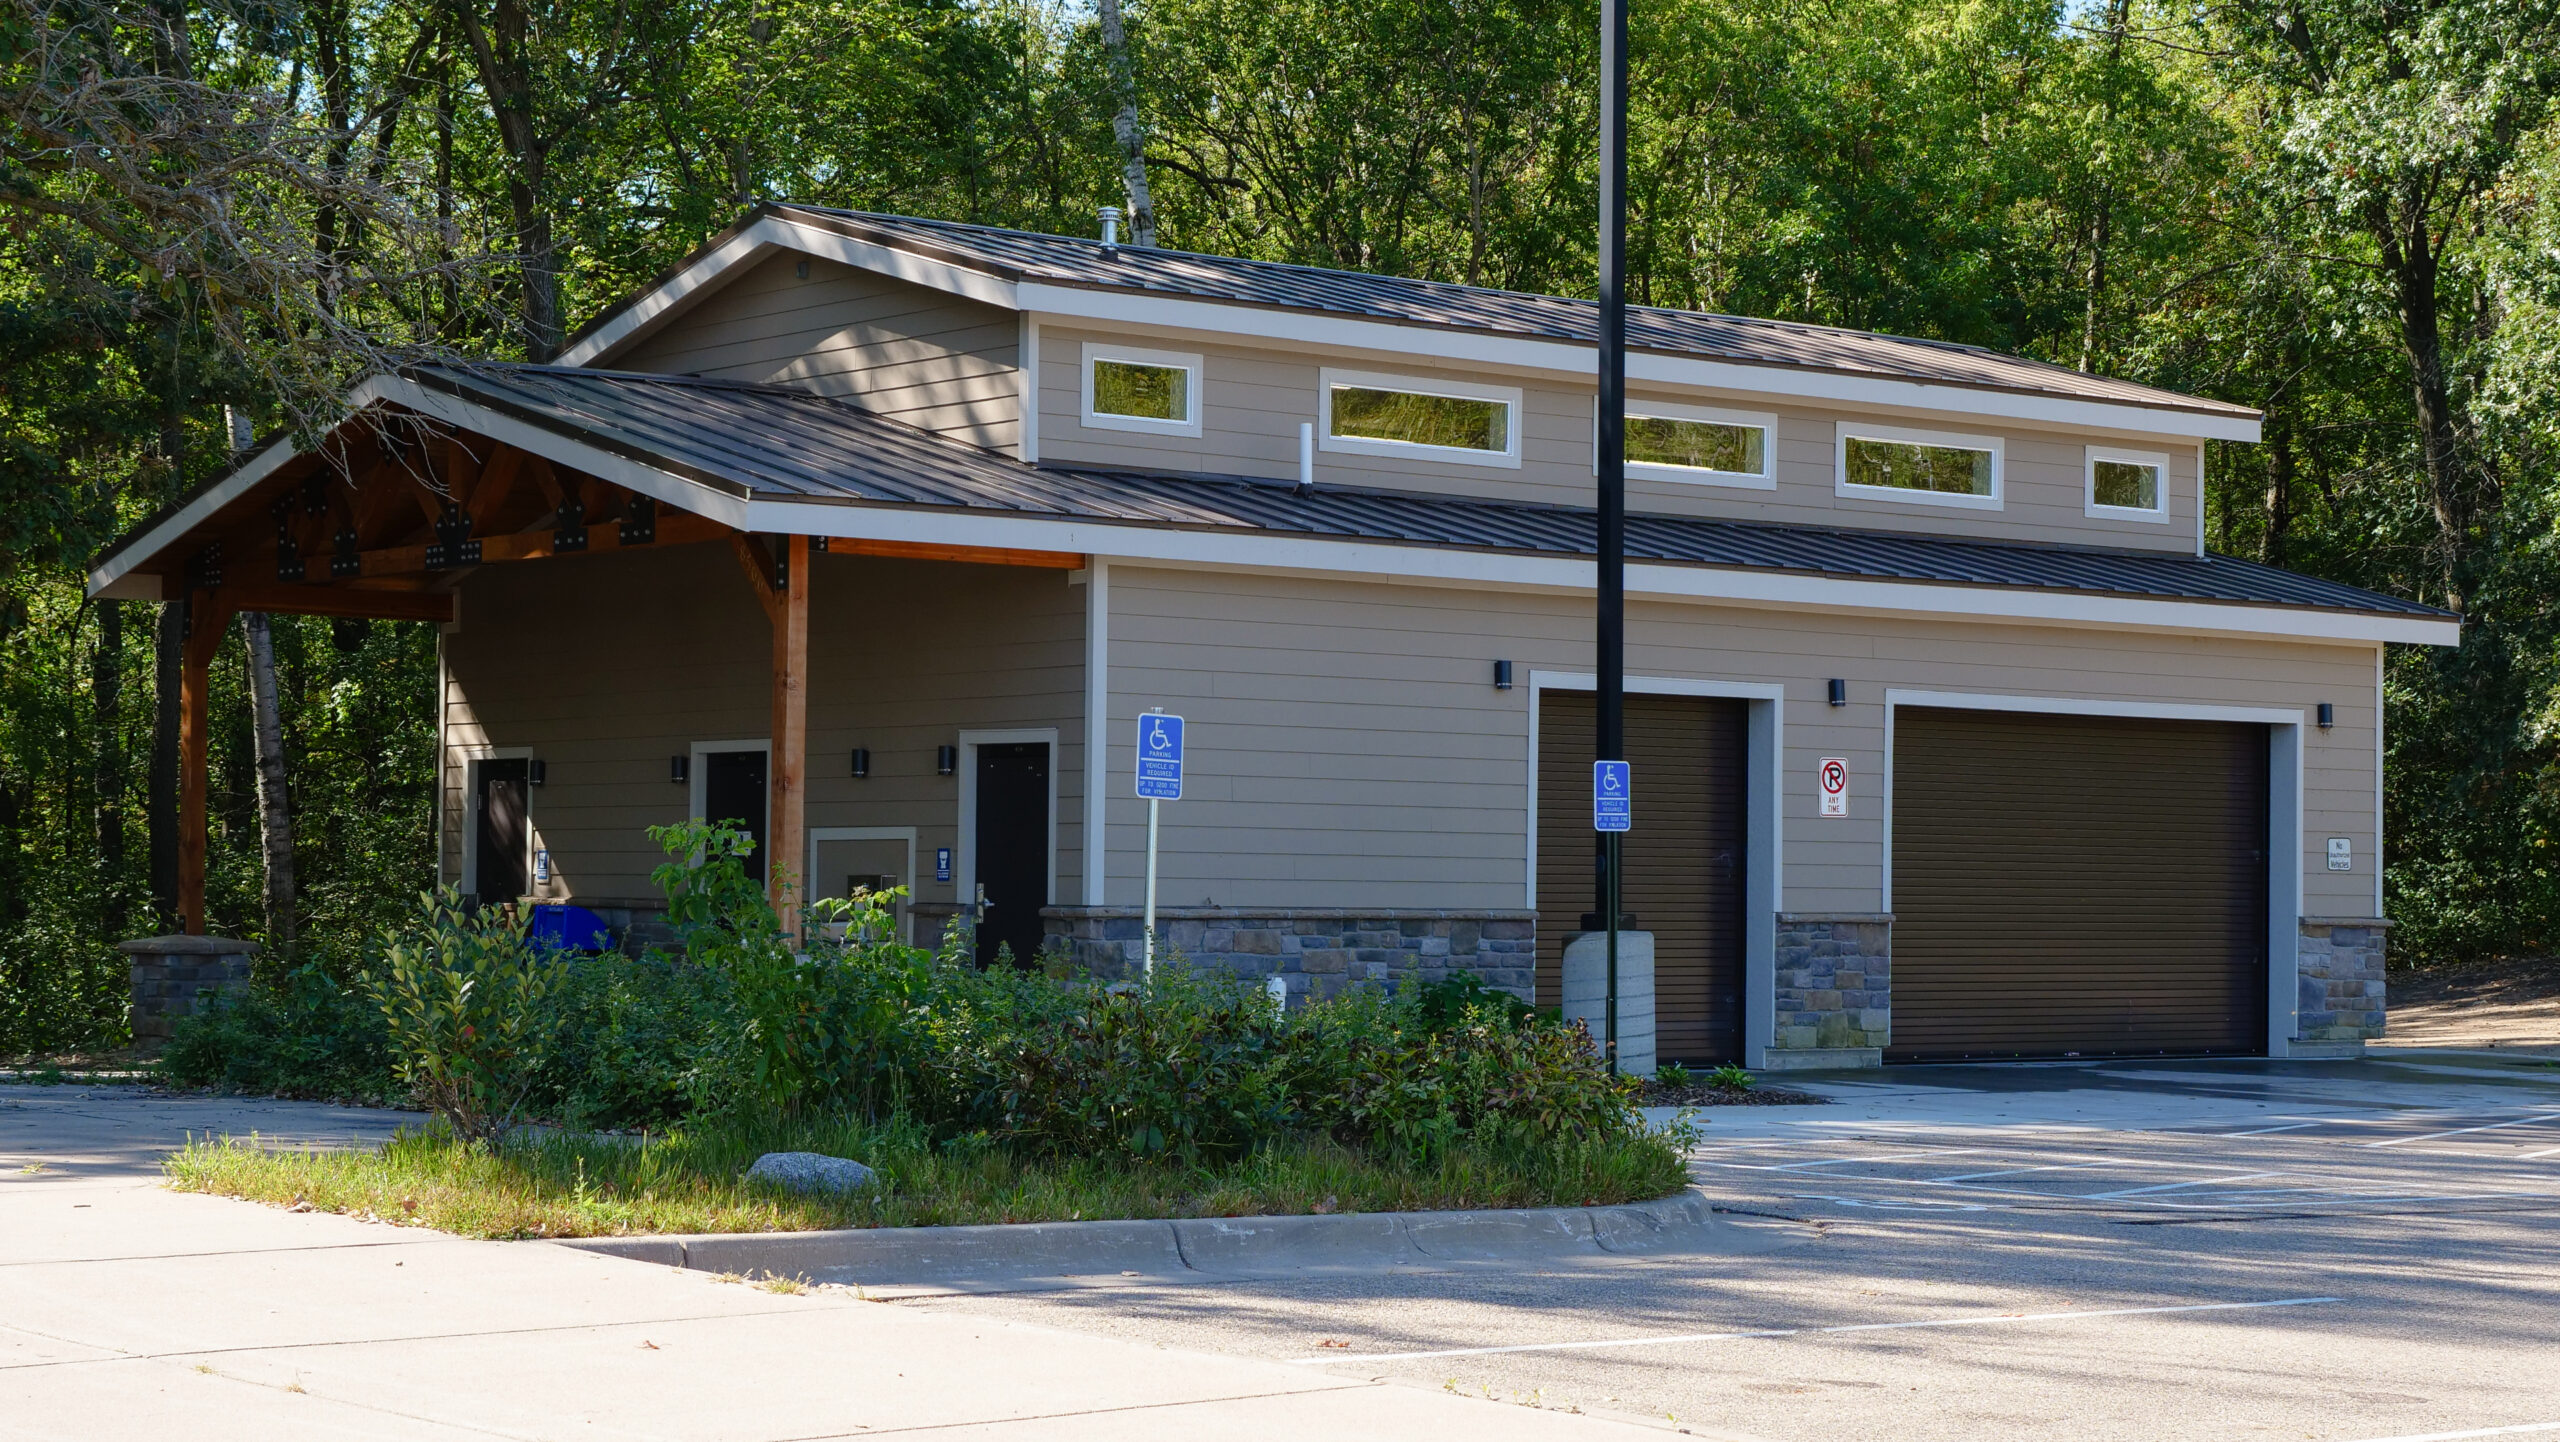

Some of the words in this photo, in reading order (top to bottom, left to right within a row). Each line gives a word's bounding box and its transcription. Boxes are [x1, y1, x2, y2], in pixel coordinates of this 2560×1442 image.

[1828, 805, 1840, 813] TIME
[2336, 841, 2342, 850] No
[2331, 860, 2349, 868] Vehicles
